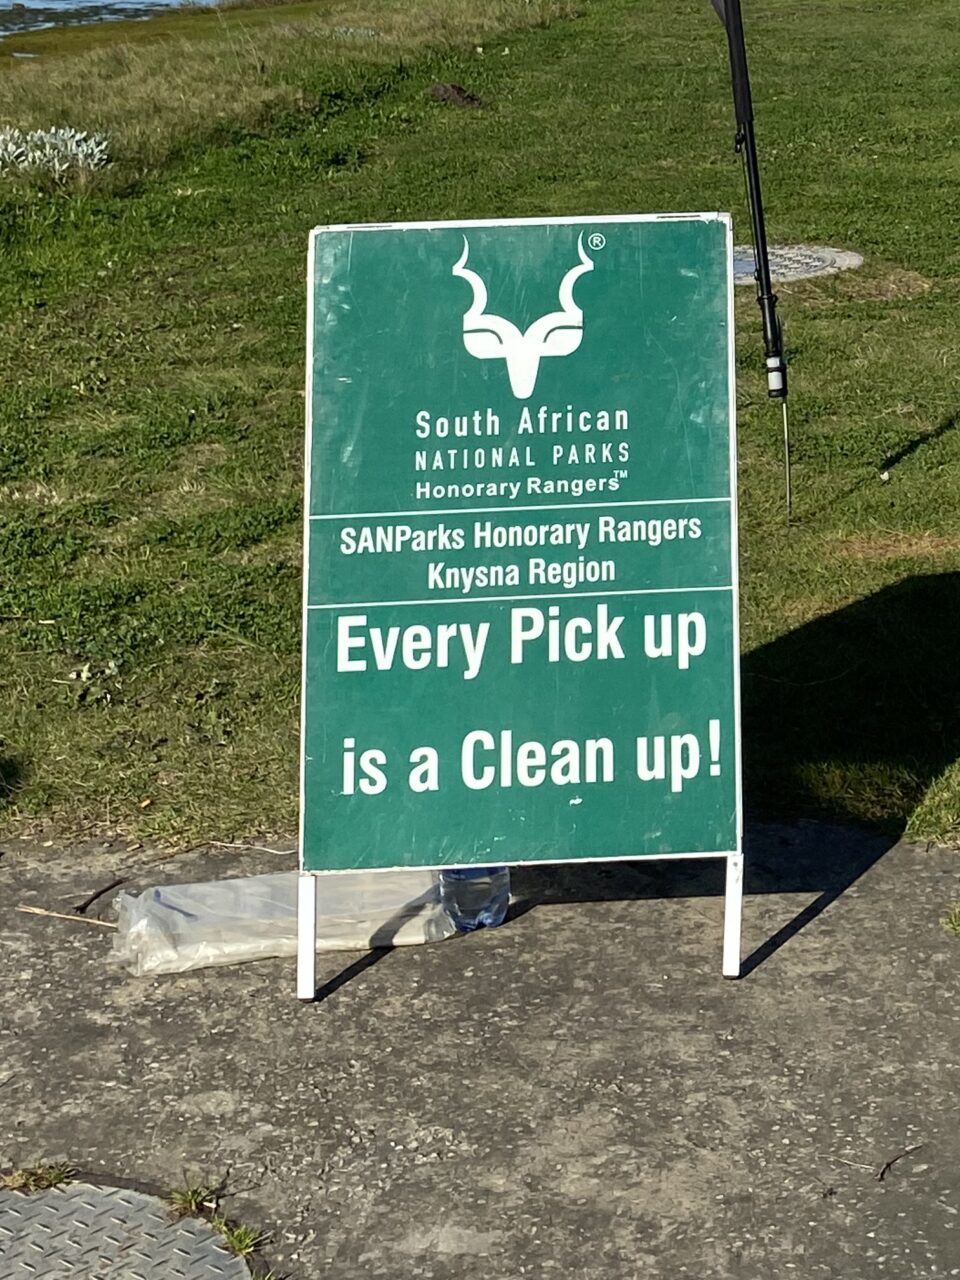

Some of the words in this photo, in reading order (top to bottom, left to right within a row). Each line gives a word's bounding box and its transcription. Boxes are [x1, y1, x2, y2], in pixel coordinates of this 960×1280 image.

[416, 408, 500, 438] South
[518, 405, 628, 434] African
[415, 446, 535, 471] NATIONAL
[553, 442, 629, 465] PARKS
[416, 482, 521, 499] Honorary
[340, 523, 465, 555] SANParks
[474, 521, 590, 550] Honorary
[598, 516, 702, 546] Rangers
[428, 562, 520, 594] Knysna
[529, 556, 615, 589] Region
[337, 615, 490, 680] Every
[511, 603, 625, 664] Pick
[644, 611, 707, 670] up
[341, 737, 387, 795] is
[408, 746, 439, 793] a
[461, 730, 614, 790] Clean
[636, 719, 721, 793] up!
